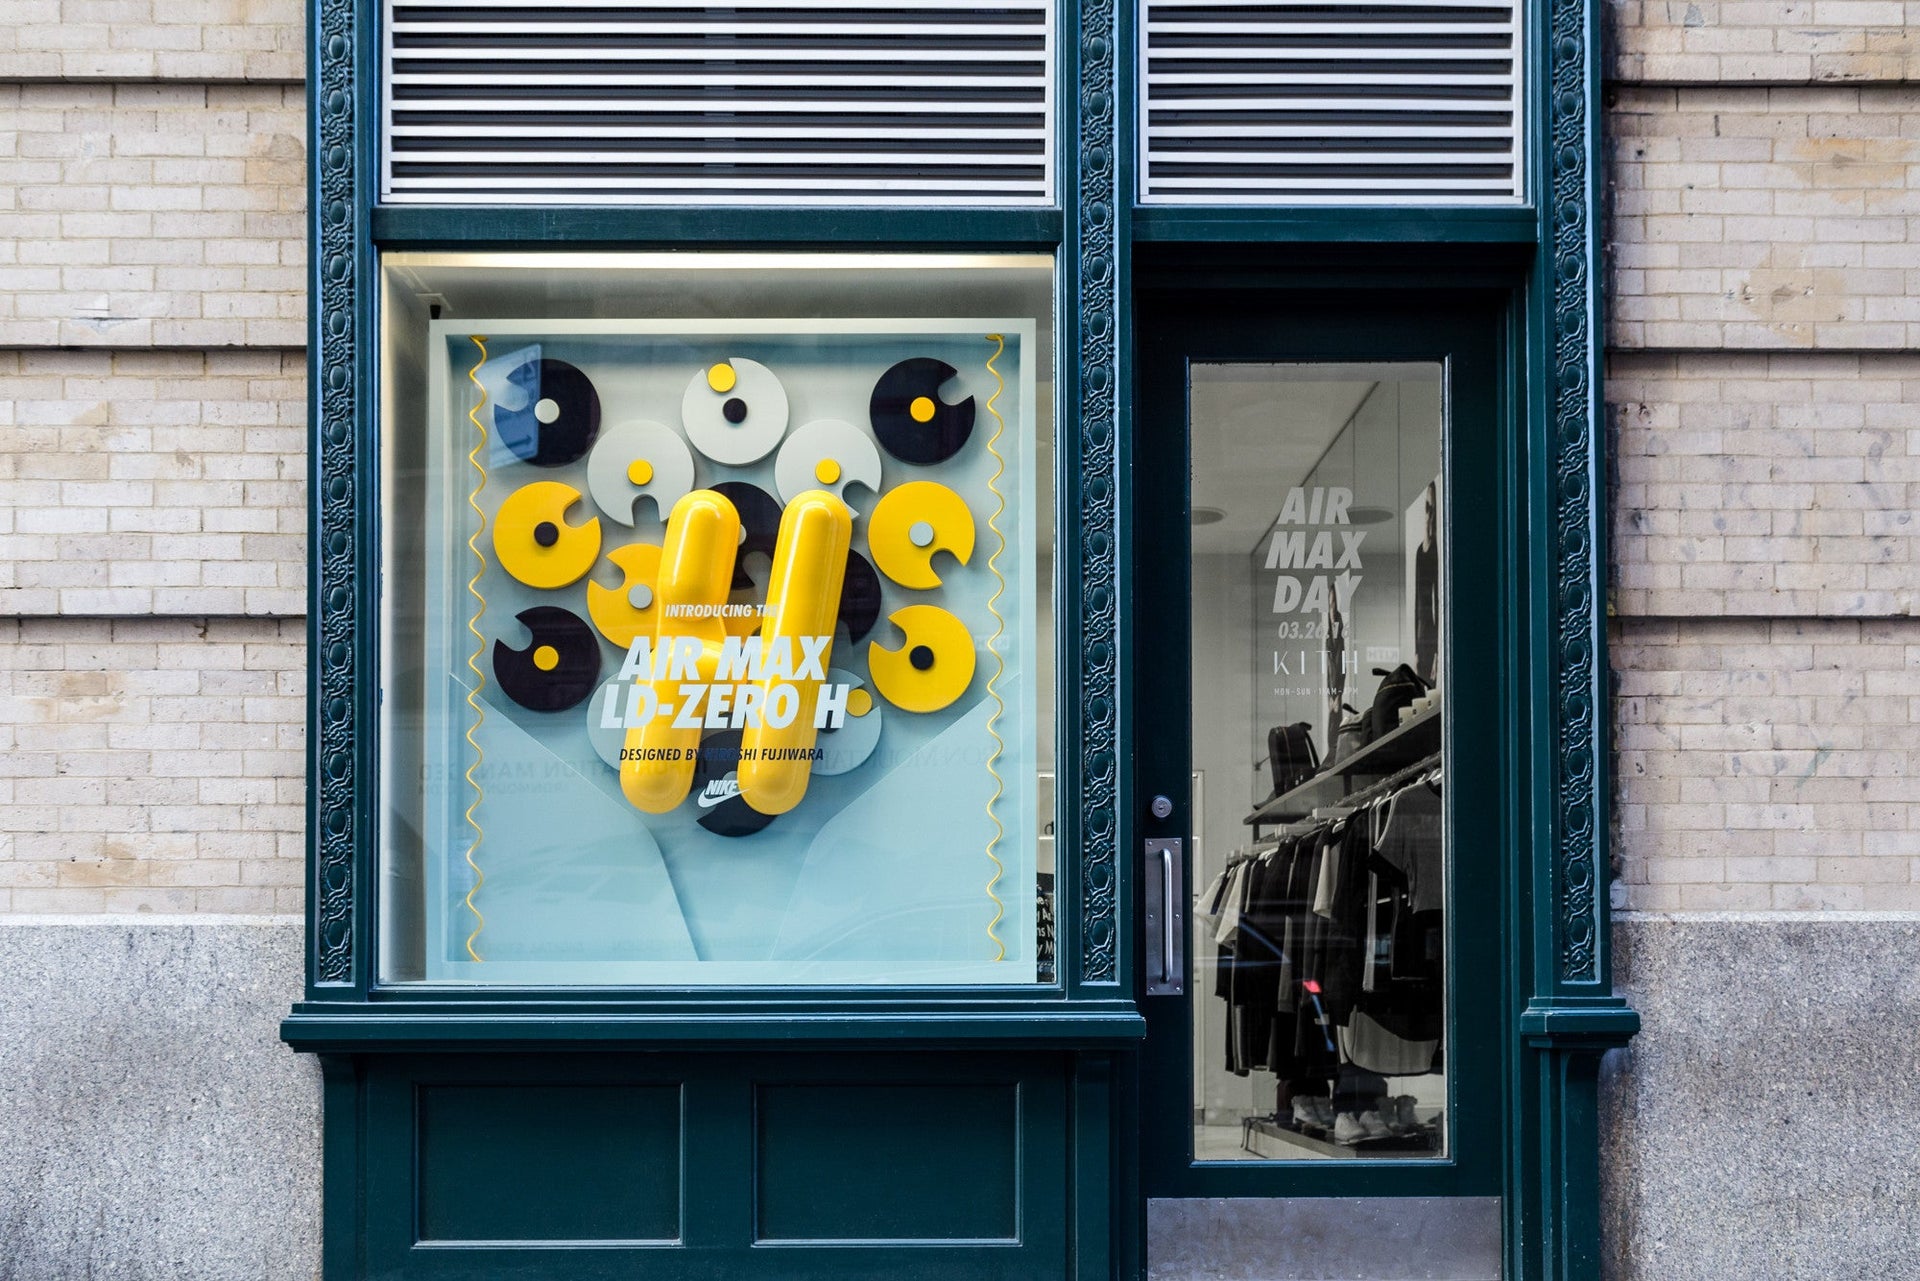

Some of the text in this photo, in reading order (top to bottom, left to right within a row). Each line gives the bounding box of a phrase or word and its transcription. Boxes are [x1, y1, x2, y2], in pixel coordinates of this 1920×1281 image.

[1277, 486, 1354, 525] AIR
[1264, 531, 1368, 569] MAX
[665, 604, 780, 618] INTRODUCING THE
[1272, 575, 1364, 614] DAY
[617, 635, 832, 681] AIR MAX
[1274, 650, 1358, 675] KITH
[600, 683, 850, 730] LD-ZERO H
[619, 748, 681, 761] DESIGNED
[686, 748, 700, 761] BY
[761, 748, 824, 761] FUJIWARA
[705, 779, 738, 796] NIKE
